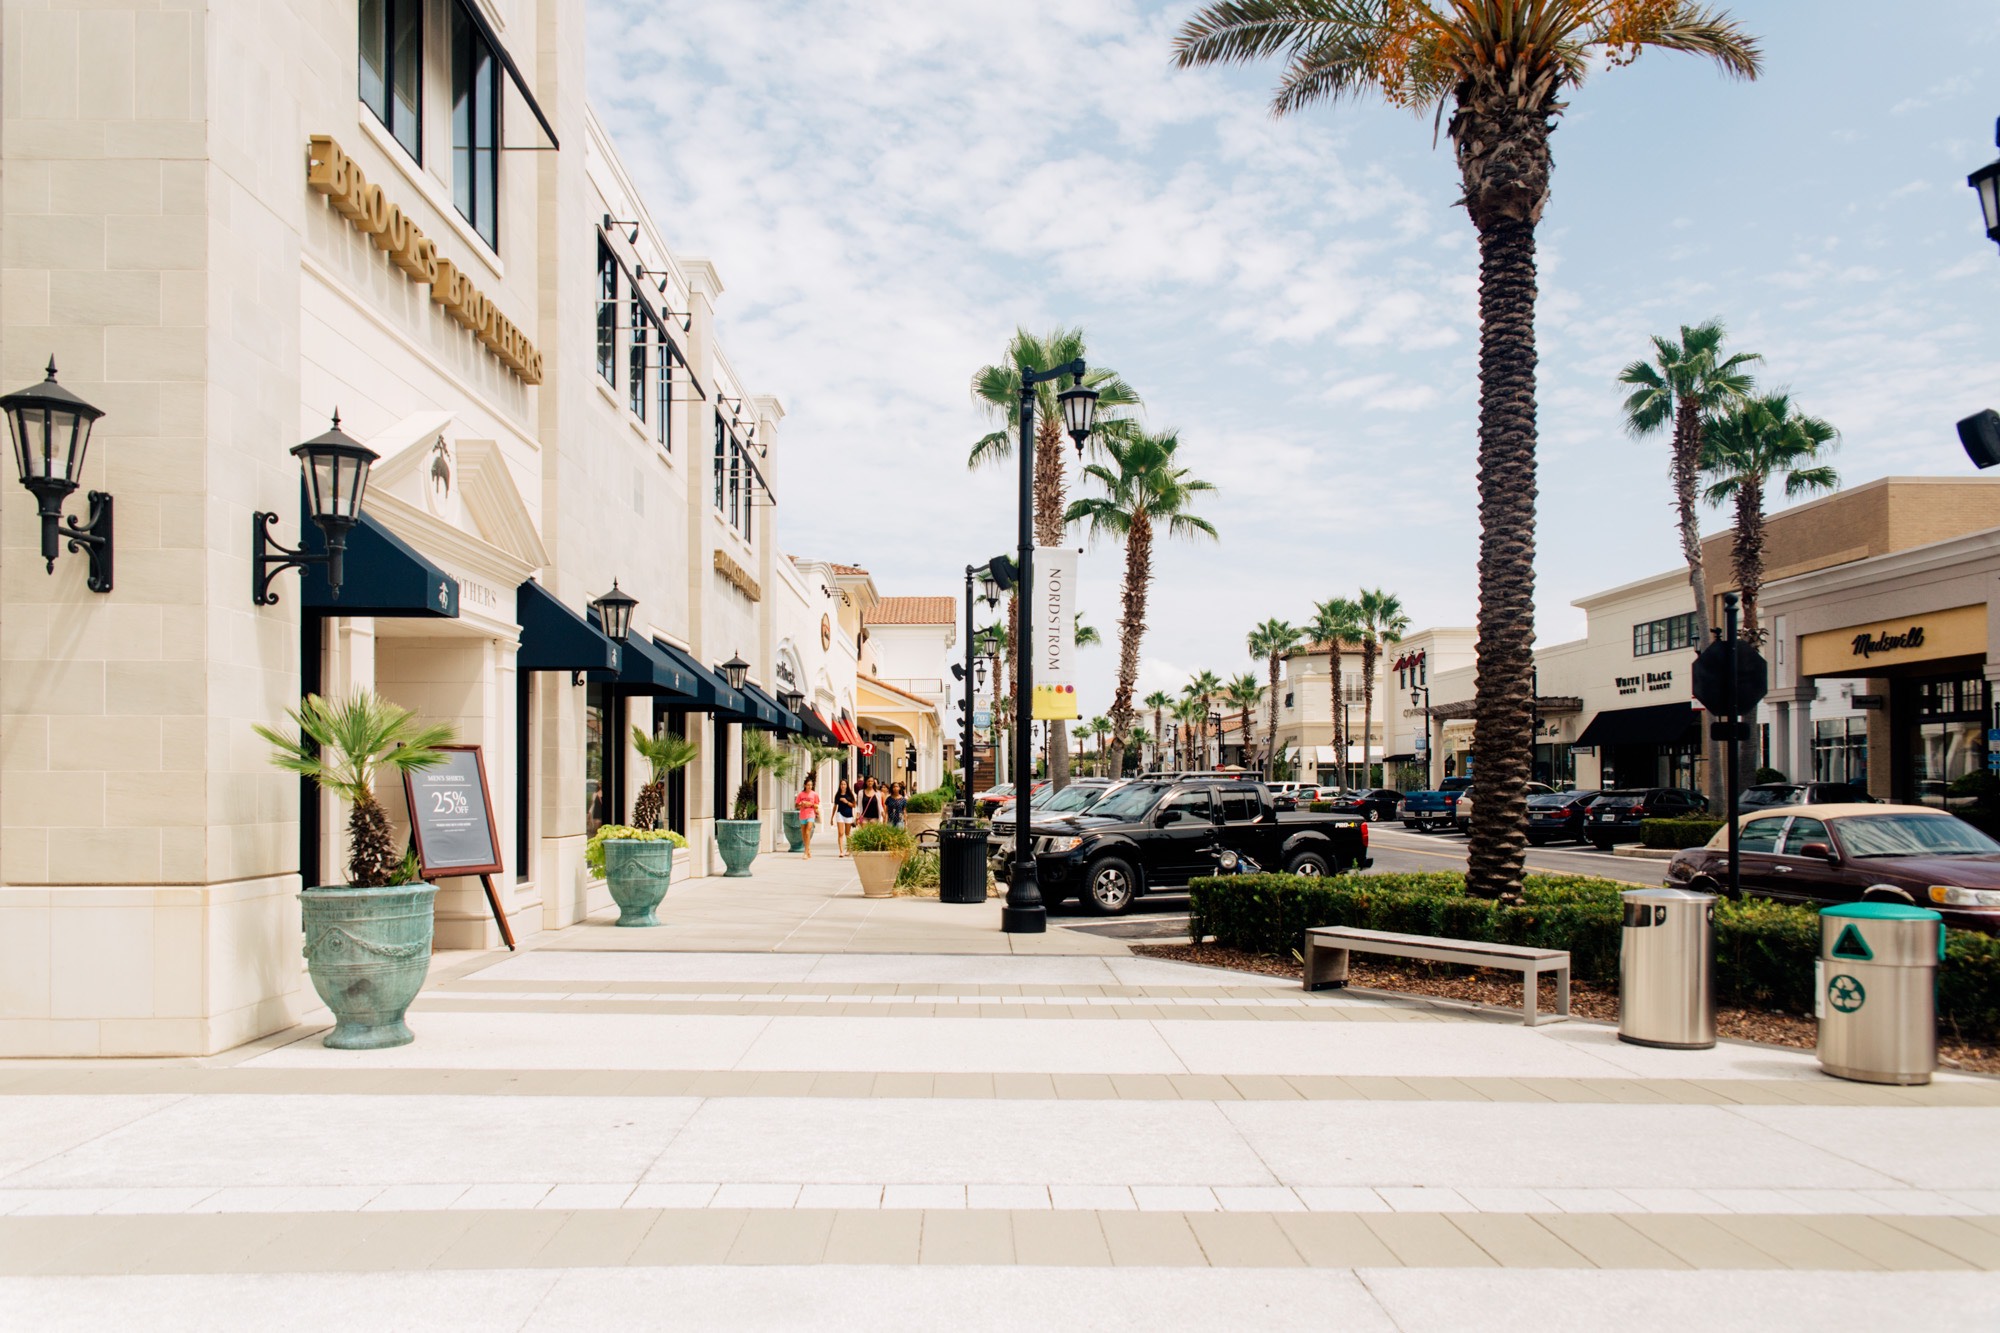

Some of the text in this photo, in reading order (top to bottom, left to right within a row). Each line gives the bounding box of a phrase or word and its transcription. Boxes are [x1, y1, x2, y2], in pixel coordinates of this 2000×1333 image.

[308, 135, 543, 385] BROOKS BROTHERS
[449, 573, 496, 609] THERS
[1047, 568, 1062, 670] NORDSTROM
[1851, 627, 1924, 658] Madewell
[1615, 671, 1672, 687] WHITE BLACK
[431, 791, 467, 814] 25%
[454, 806, 469, 814] OFF
